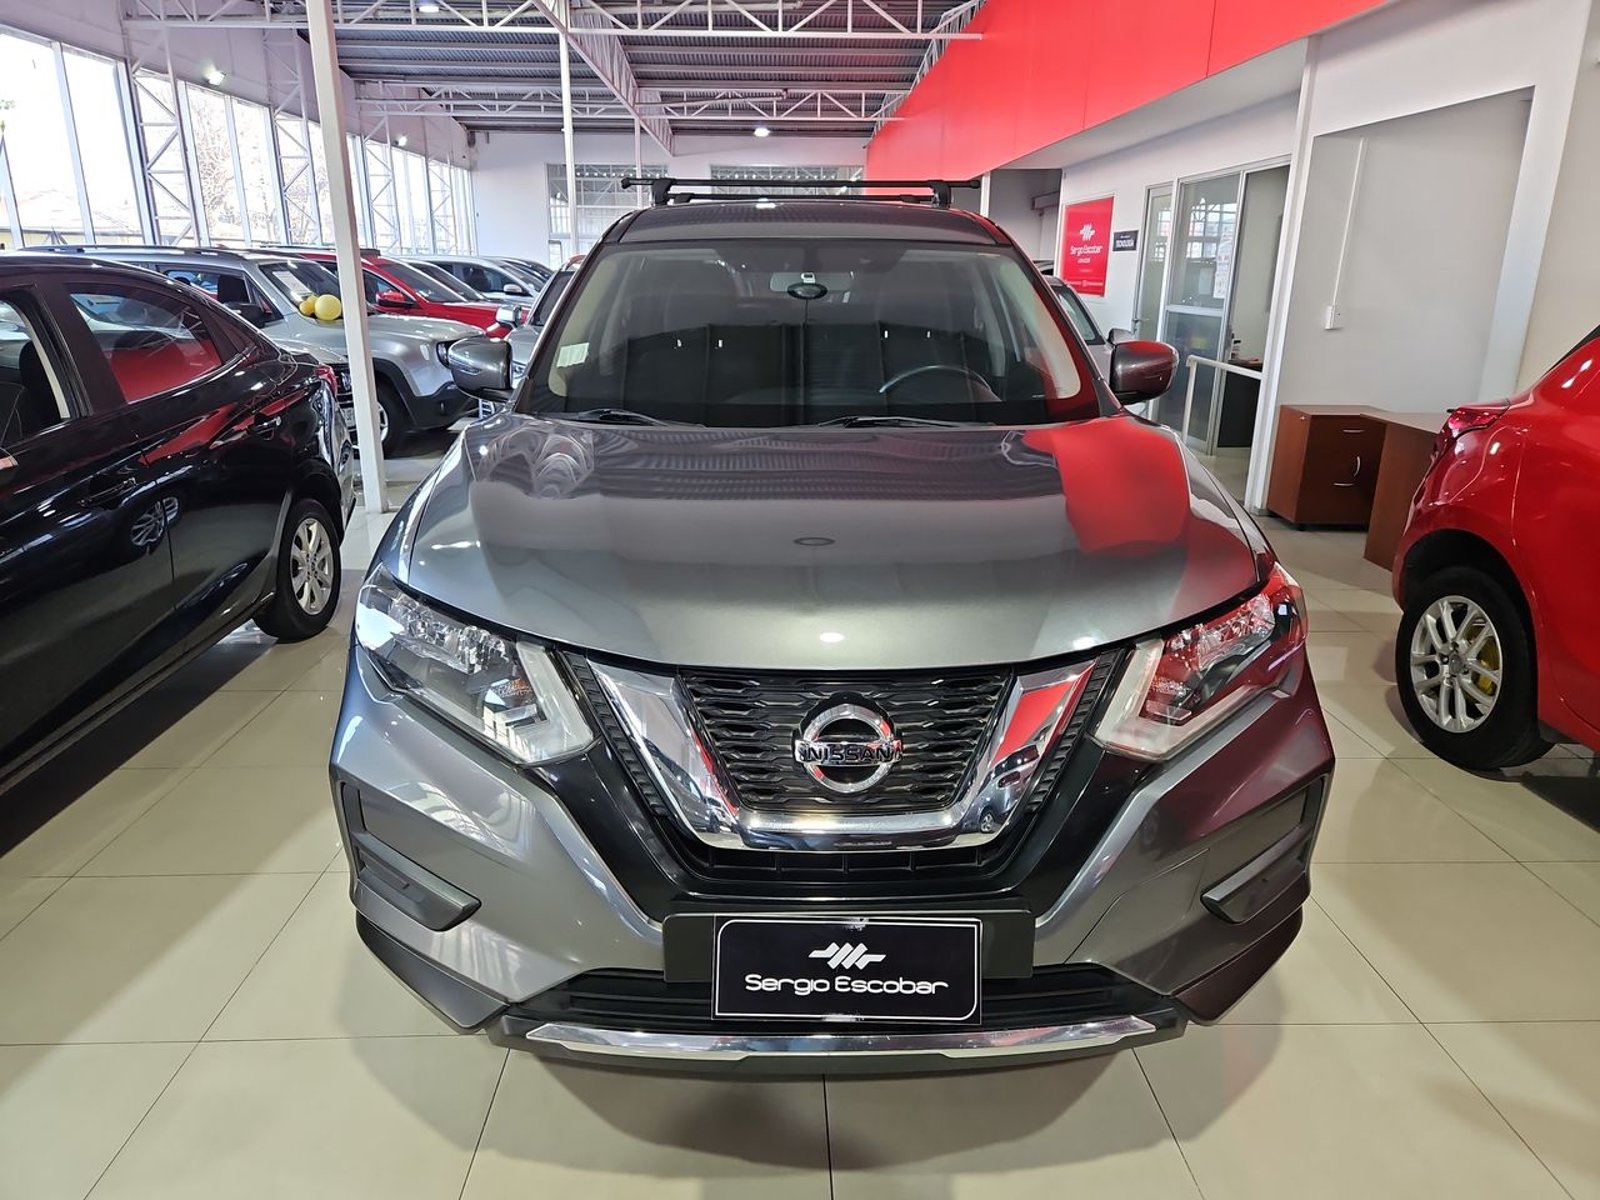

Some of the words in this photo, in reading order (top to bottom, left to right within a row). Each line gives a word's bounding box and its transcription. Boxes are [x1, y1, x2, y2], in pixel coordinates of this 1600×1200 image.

[807, 746, 891, 761] NISSAN
[744, 973, 831, 996] Sergio
[834, 975, 949, 995] Escobar
